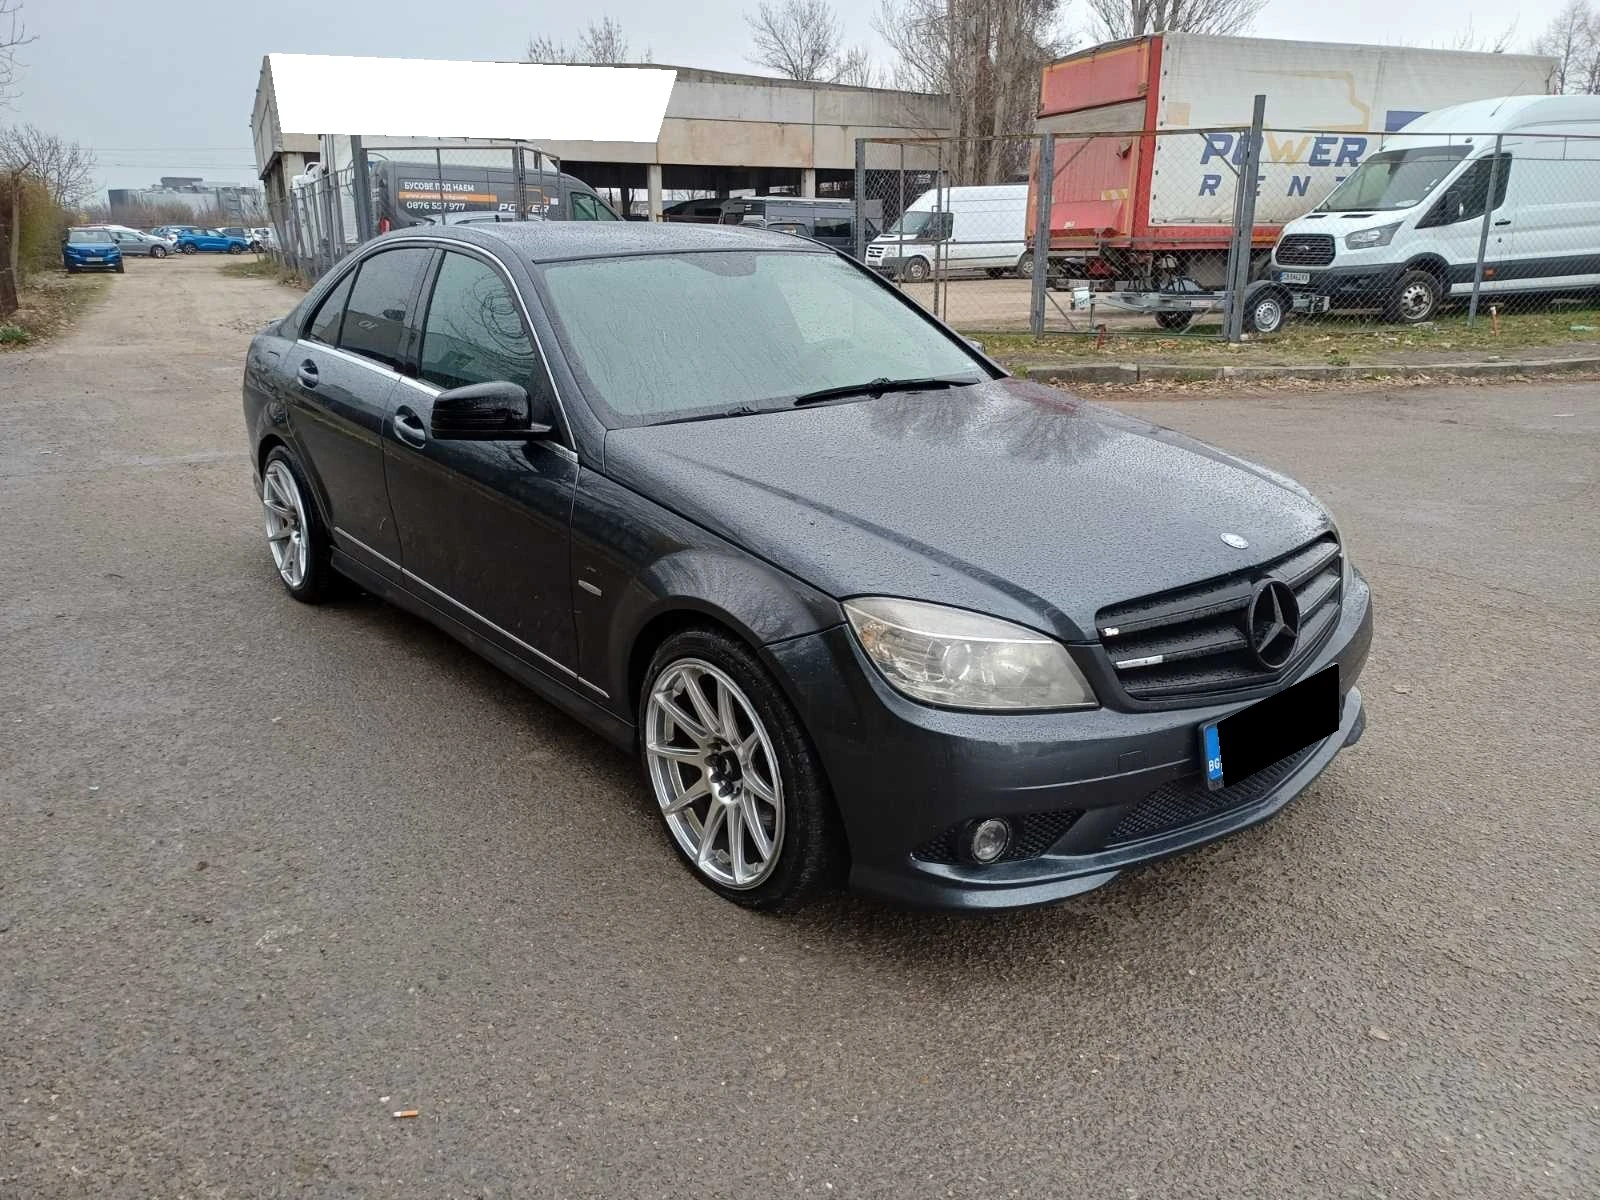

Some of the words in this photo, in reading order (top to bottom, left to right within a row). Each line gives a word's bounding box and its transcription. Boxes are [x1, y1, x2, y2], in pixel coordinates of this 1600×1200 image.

[404, 181, 434, 190] БУСОВЕ
[434, 182, 452, 192] ПОД
[452, 183, 475, 192] НАЕМ
[406, 201, 430, 209] 0876
[449, 203, 466, 211] 977
[499, 203, 549, 213] POER
[1208, 758, 1220, 771] BG
